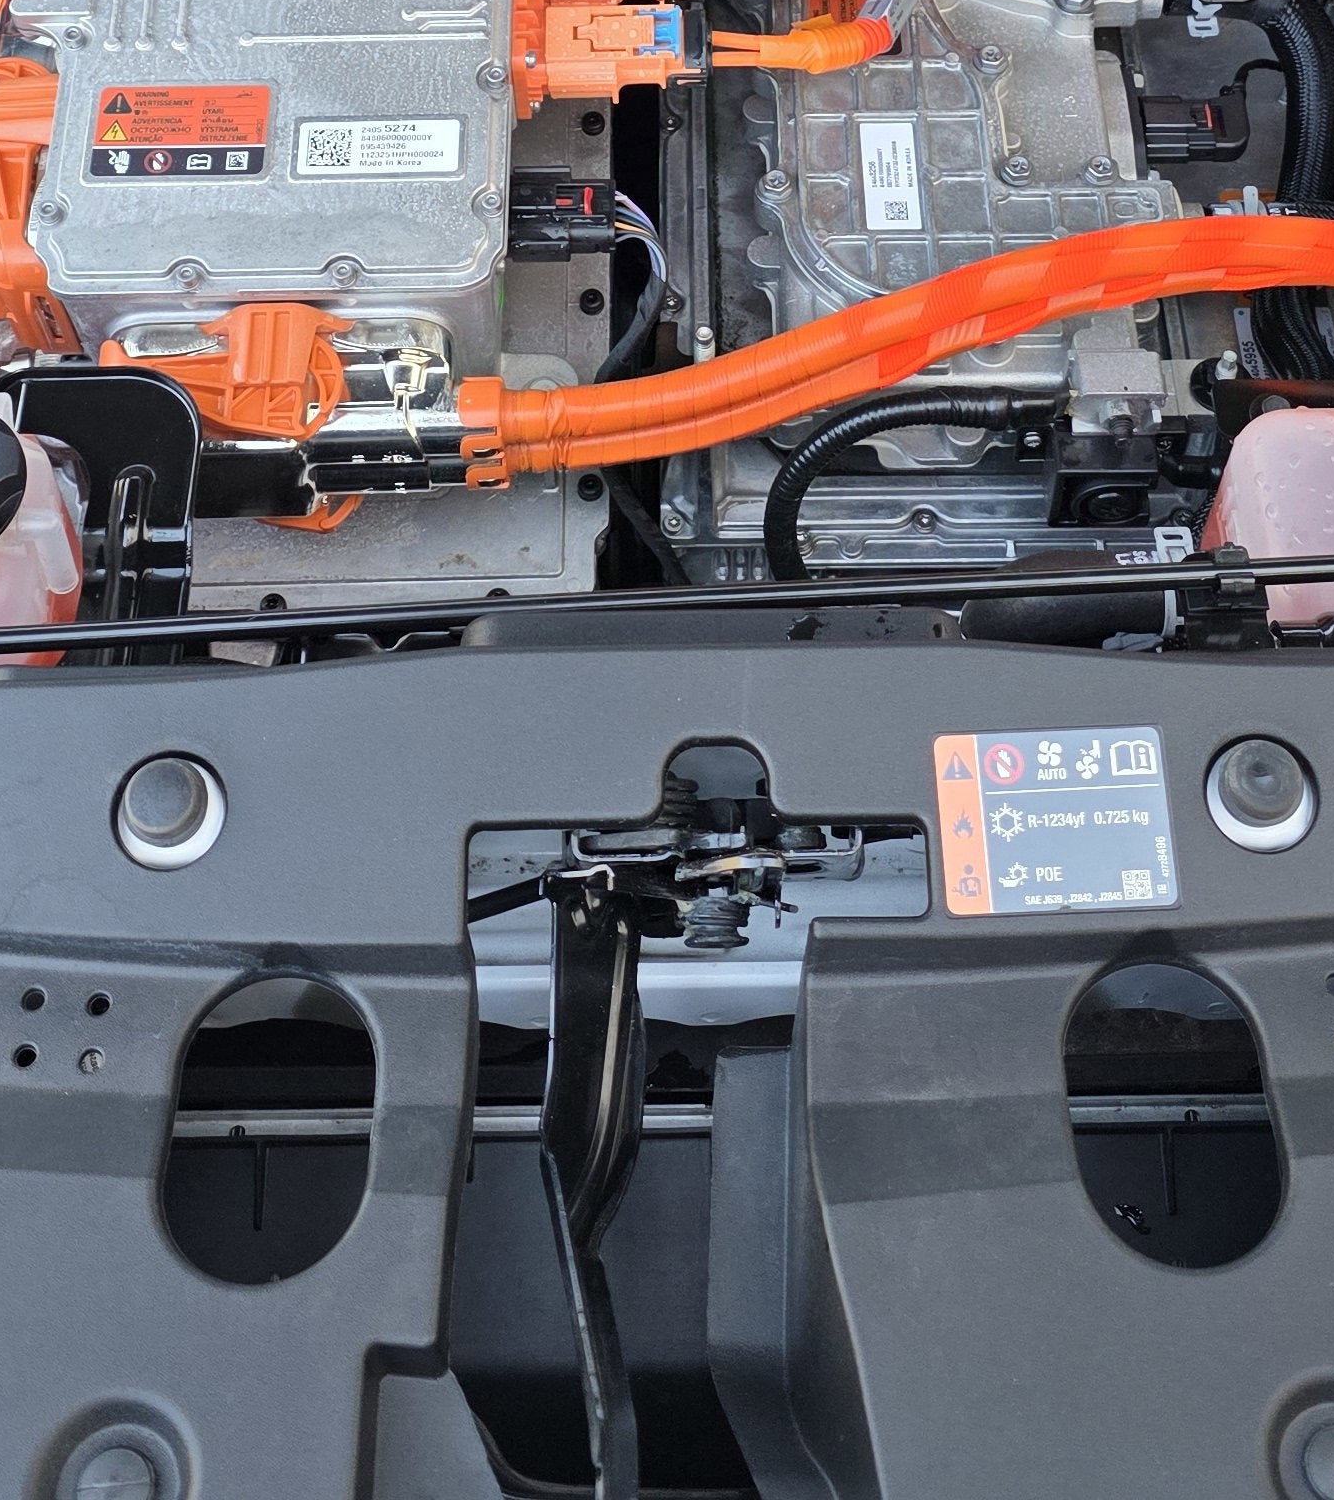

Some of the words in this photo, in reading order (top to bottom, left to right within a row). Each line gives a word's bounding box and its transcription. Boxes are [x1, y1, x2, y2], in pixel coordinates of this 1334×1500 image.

[384, 124, 416, 132] 5274
[1037, 768, 1067, 780] AUTO
[1027, 811, 1086, 829] R-1234yf
[1093, 810, 1130, 825] 0.725
[1132, 810, 1149, 824] kg
[1035, 867, 1063, 882] POE
[1024, 895, 1042, 905] SAE
[1042, 895, 1063, 904] J639
[1068, 894, 1093, 903] J2842
[1098, 892, 1123, 902] J2845
